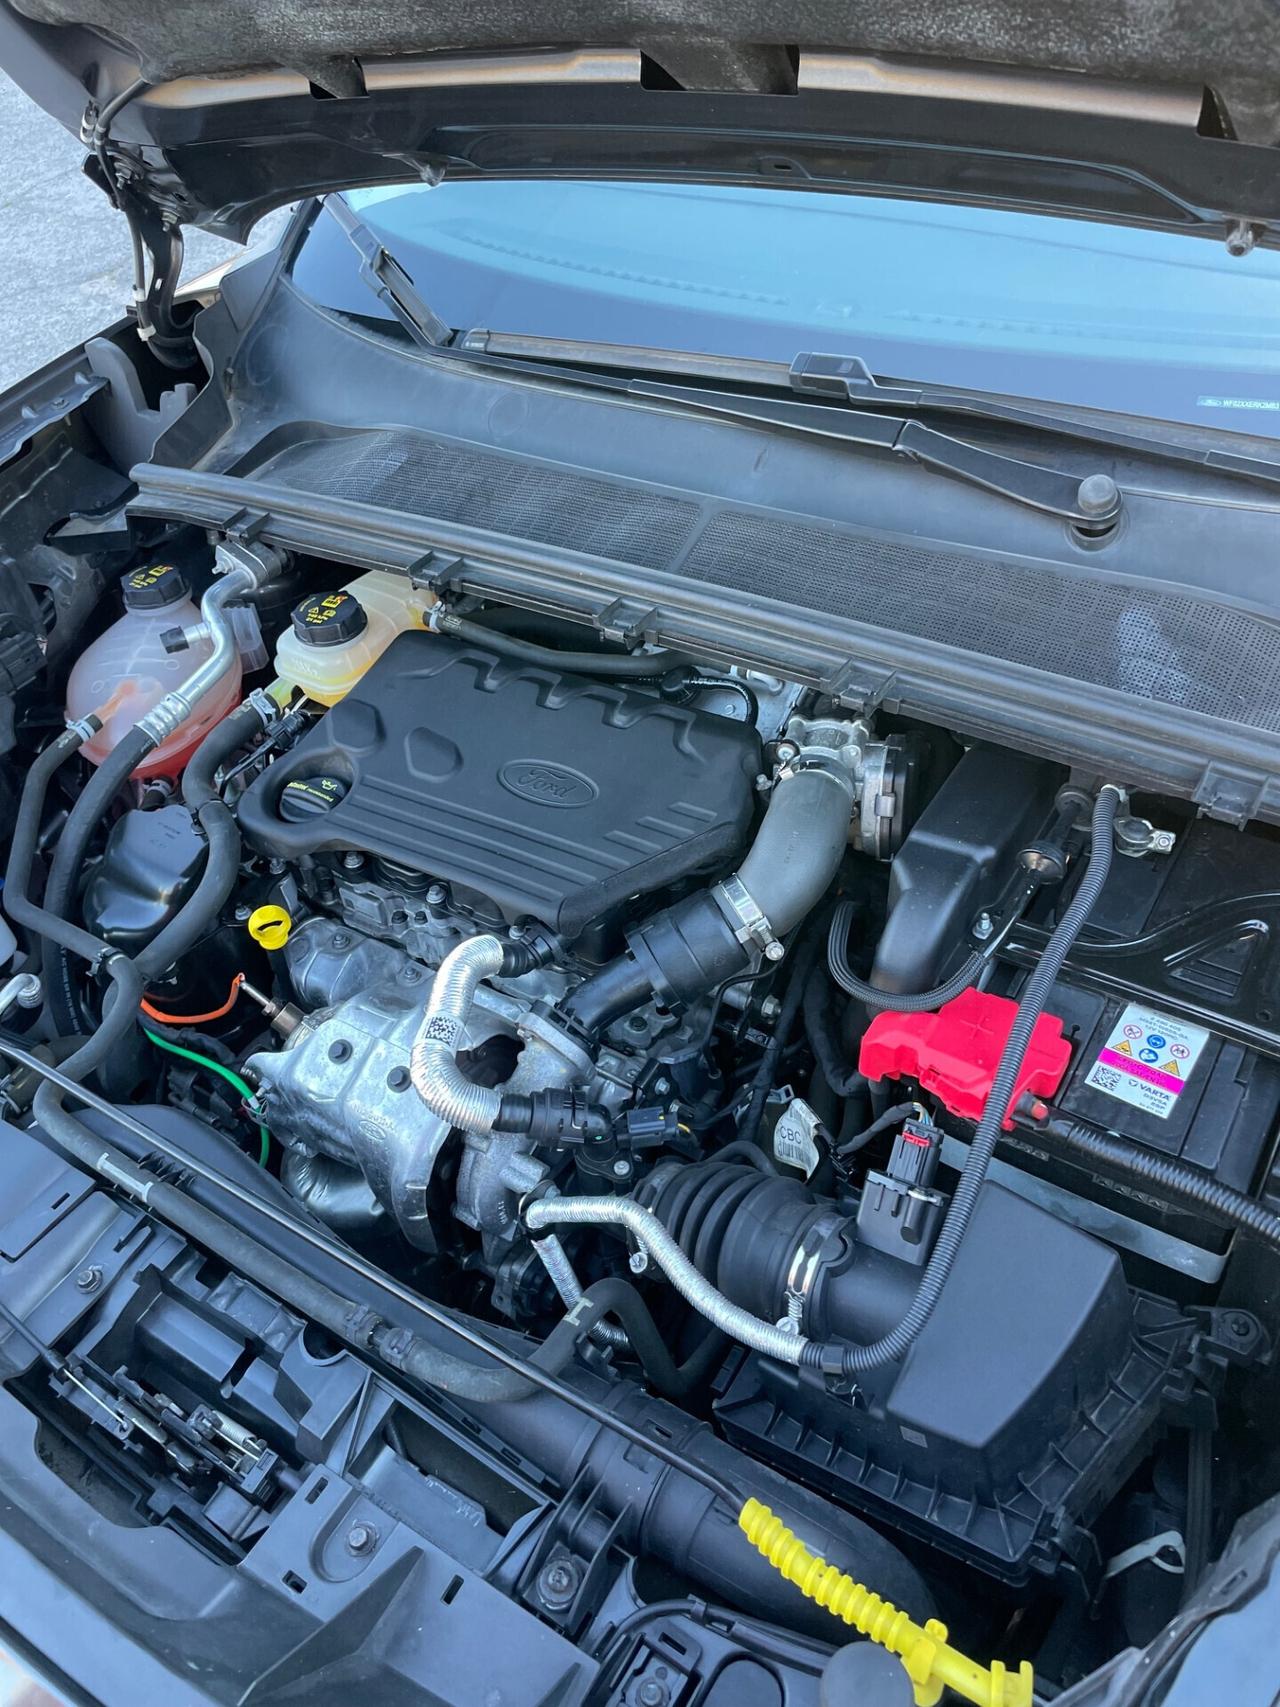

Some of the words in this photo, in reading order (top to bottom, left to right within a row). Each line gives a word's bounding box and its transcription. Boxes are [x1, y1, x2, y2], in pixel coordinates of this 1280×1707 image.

[516, 768, 578, 799] Ford
[1140, 1084, 1170, 1101] VARTA
[779, 1126, 802, 1145] CBC
